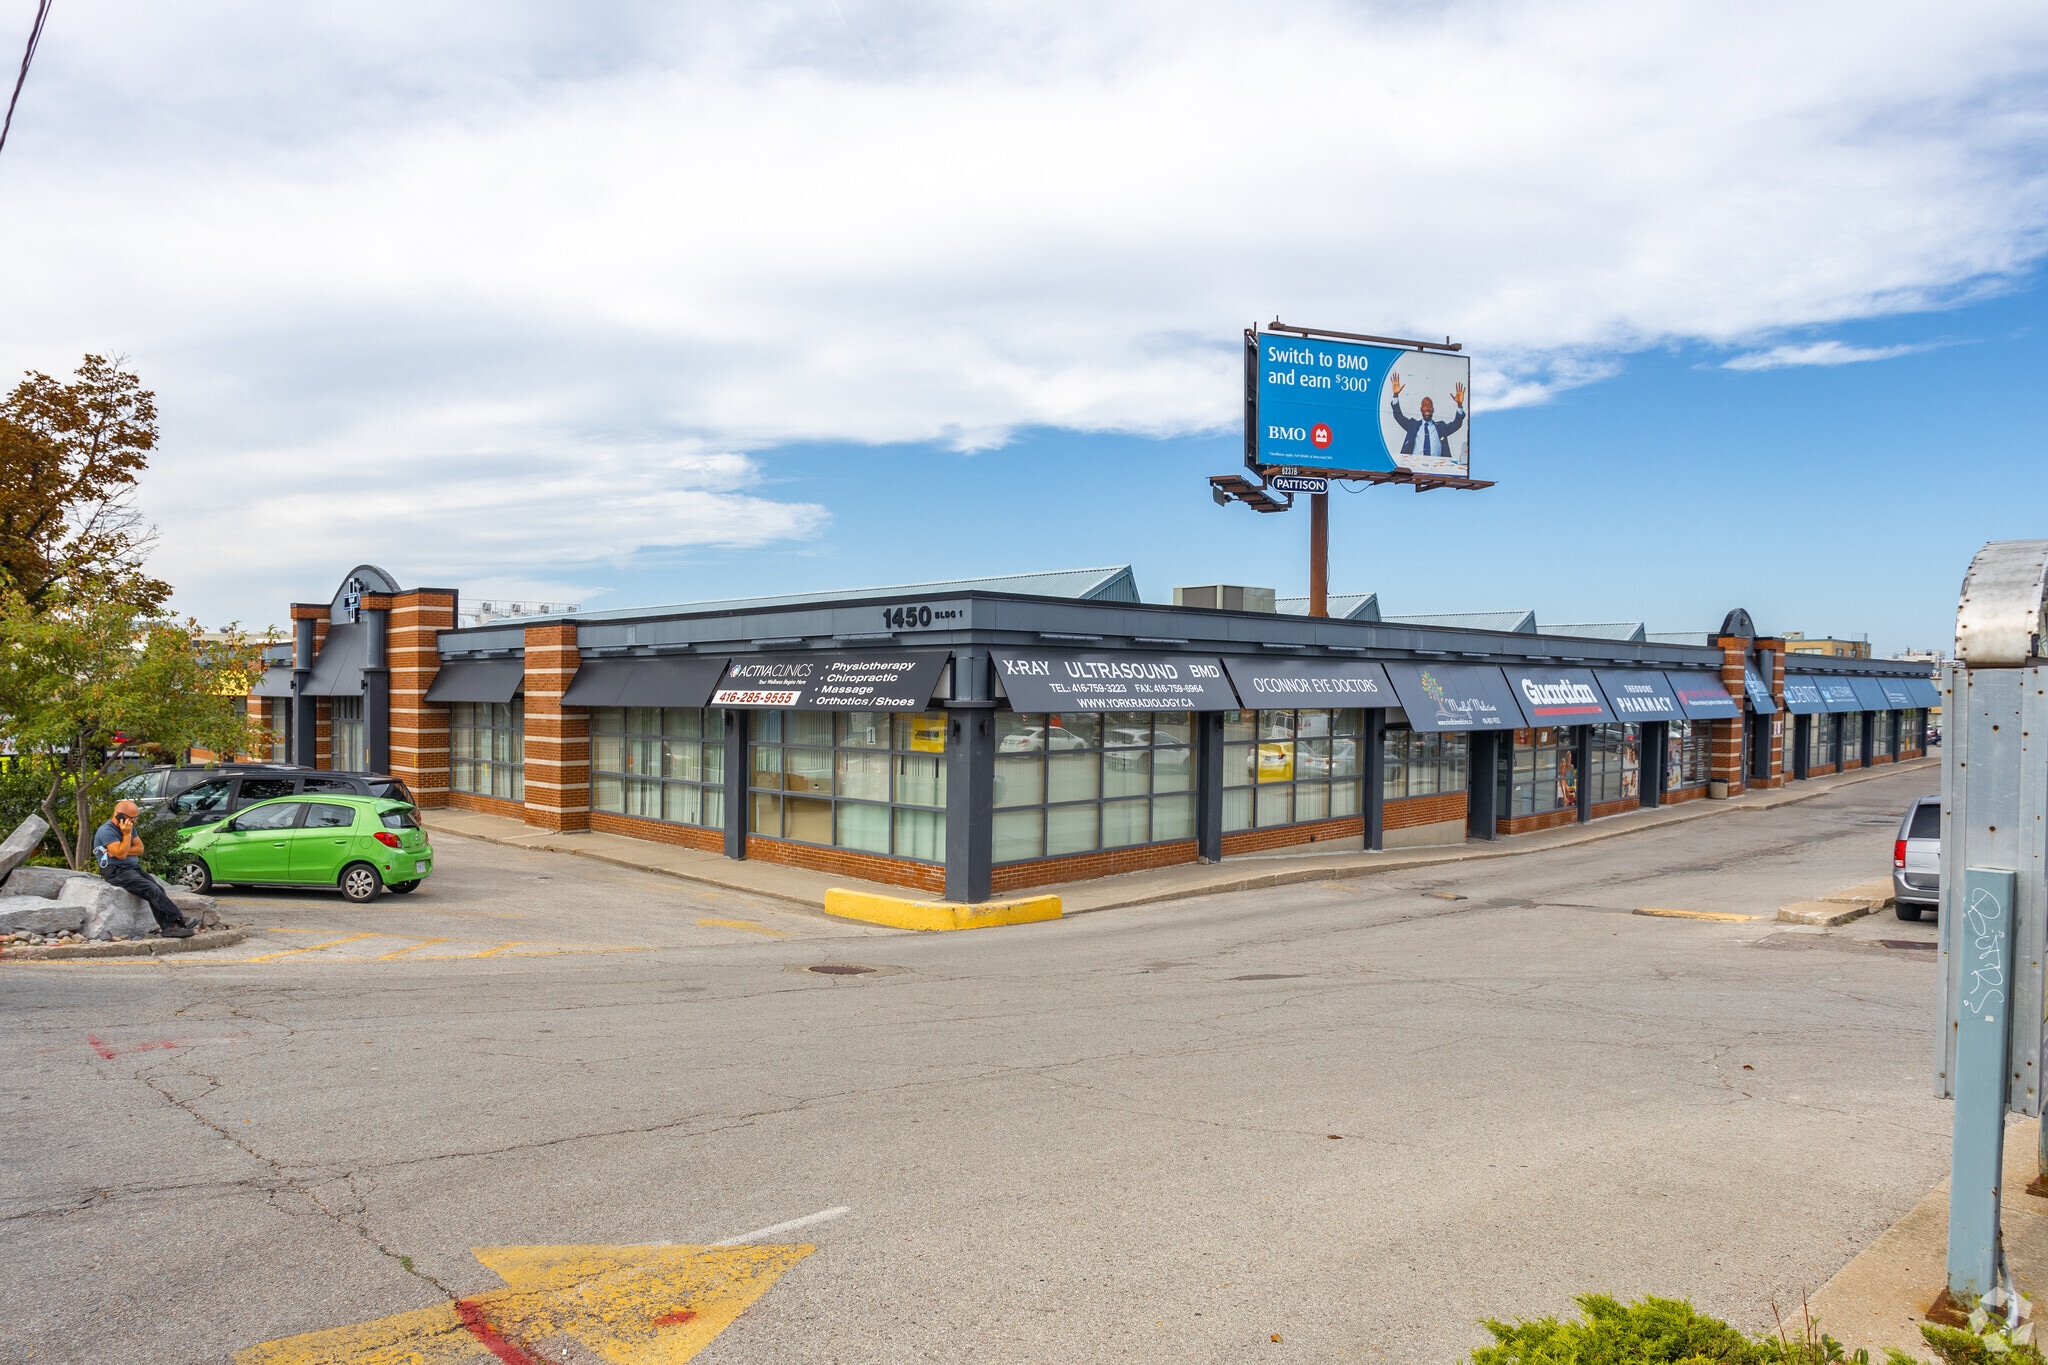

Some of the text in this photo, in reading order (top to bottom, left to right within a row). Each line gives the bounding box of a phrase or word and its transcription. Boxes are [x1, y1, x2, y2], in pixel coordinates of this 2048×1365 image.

[1268, 346, 1369, 371] Switch to BMO
[1268, 369, 1295, 386] and
[1299, 374, 1331, 389] earn
[1268, 425, 1306, 441] BMO
[1276, 478, 1325, 491] PATTISON
[883, 605, 963, 629] 1450 BLDG 1
[738, 663, 814, 677] ACTIVACLINICS
[831, 662, 916, 672] Physiotherapy
[1002, 660, 1220, 679] X-RAY ULTRASOUND BMD
[826, 673, 898, 684] Chiropractic
[1253, 677, 1378, 693] O'CONNOR EYE DOCTORS
[821, 685, 874, 695] Massage
[1049, 683, 1071, 693] TEL:
[1072, 683, 1128, 693] 416-759-3223
[1134, 684, 1154, 693] FAX:
[1521, 678, 1599, 706] Guardian
[1623, 684, 1654, 694] THEODORE
[719, 691, 793, 704] 416-285-9555
[1076, 698, 1195, 708] WWW.YORKRADIOLOGY.CA
[1616, 697, 1675, 713] PHARMACY
